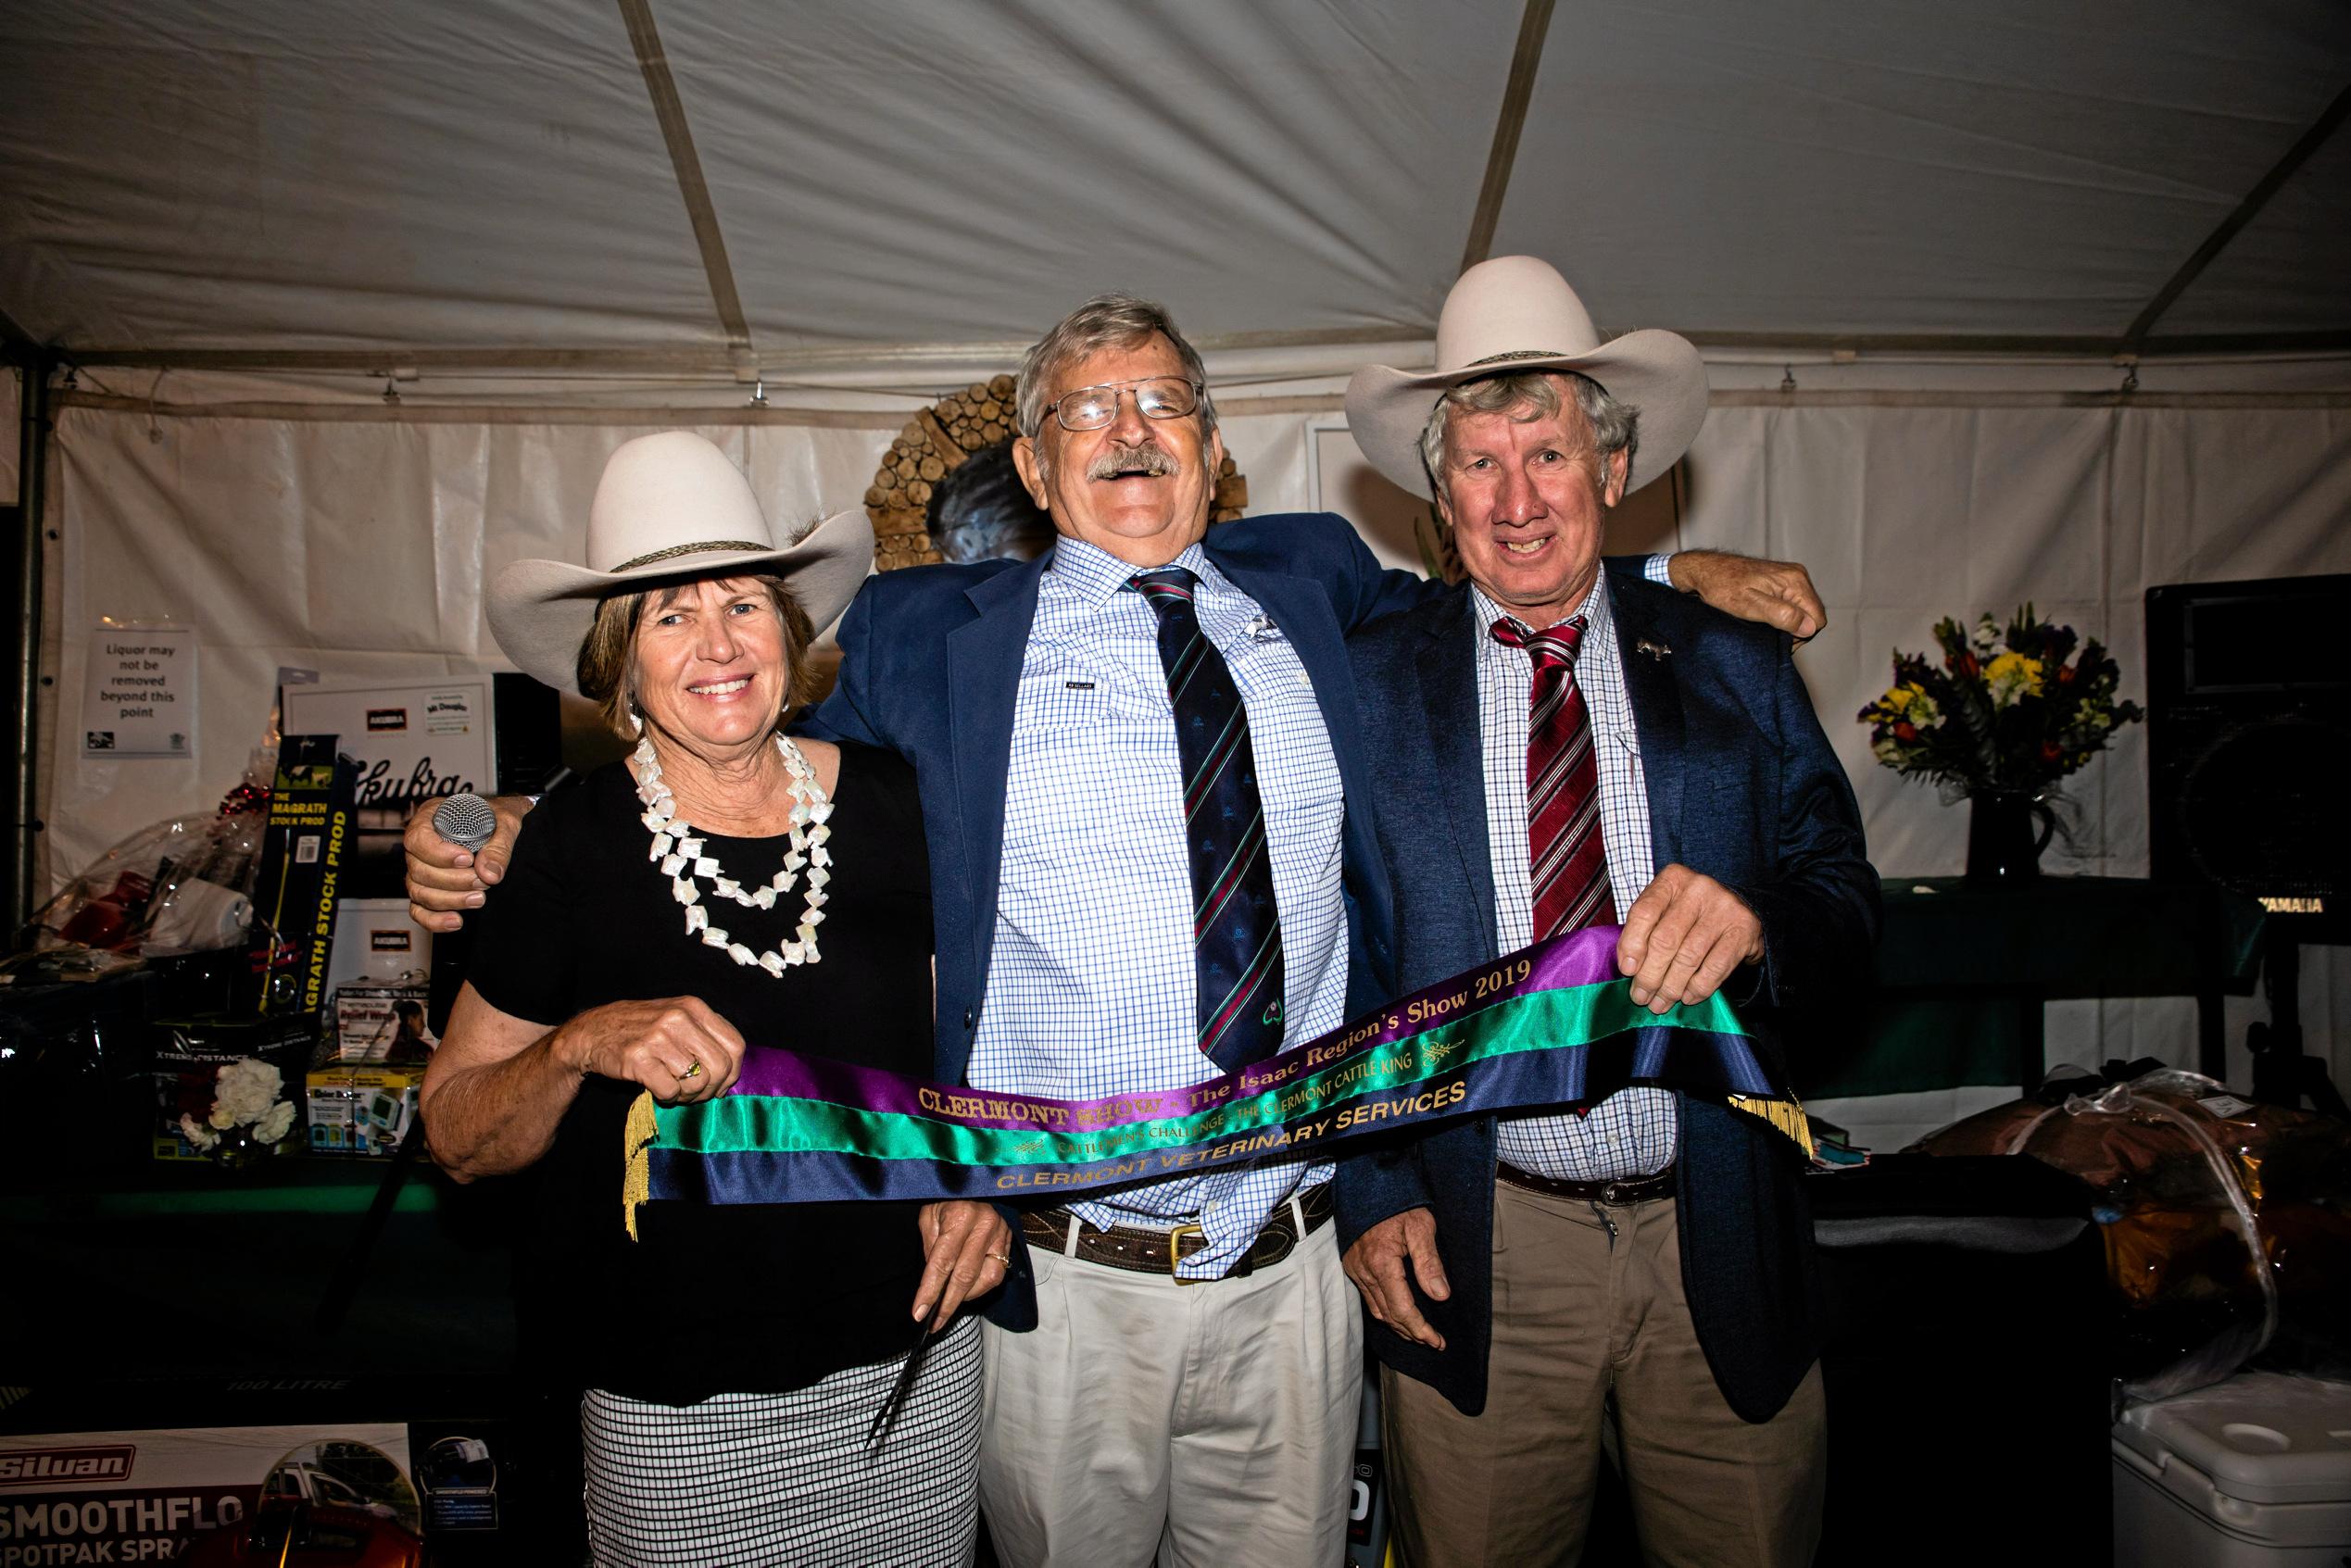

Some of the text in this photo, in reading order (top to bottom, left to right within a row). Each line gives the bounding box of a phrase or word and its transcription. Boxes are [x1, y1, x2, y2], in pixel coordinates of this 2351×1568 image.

[107, 644, 176, 657] Liquor may
[119, 659, 159, 670] not be
[111, 675, 166, 686] removed
[101, 691, 174, 703] beyond this
[120, 708, 154, 719] point
[273, 793, 291, 801] THE
[271, 803, 328, 814] MAGRATH
[299, 816, 325, 825] PROD
[326, 810, 346, 868] PROD
[316, 871, 338, 936] STOCK
[2257, 897, 2323, 912] YAMAHA
[918, 1087, 1069, 1126] CLERMONT
[1076, 1098, 1164, 1126] SHOW
[1188, 1084, 1231, 1108] The
[1239, 1060, 1299, 1090] Isaac
[1306, 1013, 1400, 1067] Region's
[1407, 991, 1467, 1023] Show
[1475, 959, 1531, 998] 2019
[1058, 1129, 1145, 1156] CATTLEMEN'S
[1149, 1113, 1225, 1139] CHALLENGE
[1238, 1104, 1259, 1119] THE
[1264, 1081, 1332, 1114] CLERMONT
[1335, 1064, 1377, 1089] CATTLE
[1380, 1053, 1412, 1074] KING
[997, 1081, 1465, 1189] CLERMONT VETERINARY SERVICES
[228, 1380, 351, 1391] 100 LITRE
[0, 1540, 115, 1568] POTPAK
